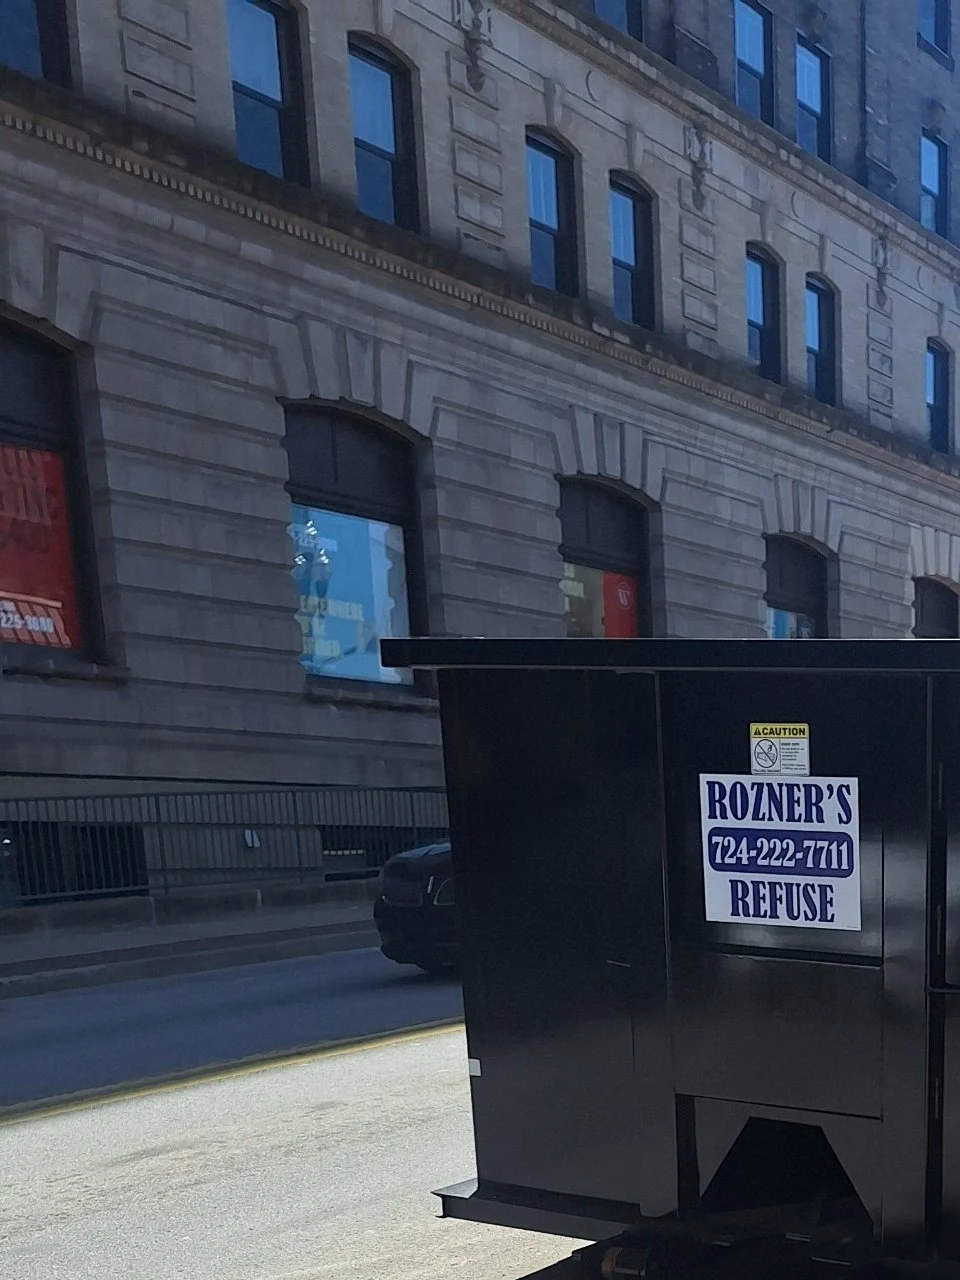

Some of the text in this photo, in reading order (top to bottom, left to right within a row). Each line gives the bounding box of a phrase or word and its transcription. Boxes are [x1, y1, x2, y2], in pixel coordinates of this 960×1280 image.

[761, 727, 806, 736] CAUTION
[706, 780, 853, 825] ROZNER'S
[711, 836, 849, 870] 724-222-7711
[729, 879, 835, 923] REFUSE
